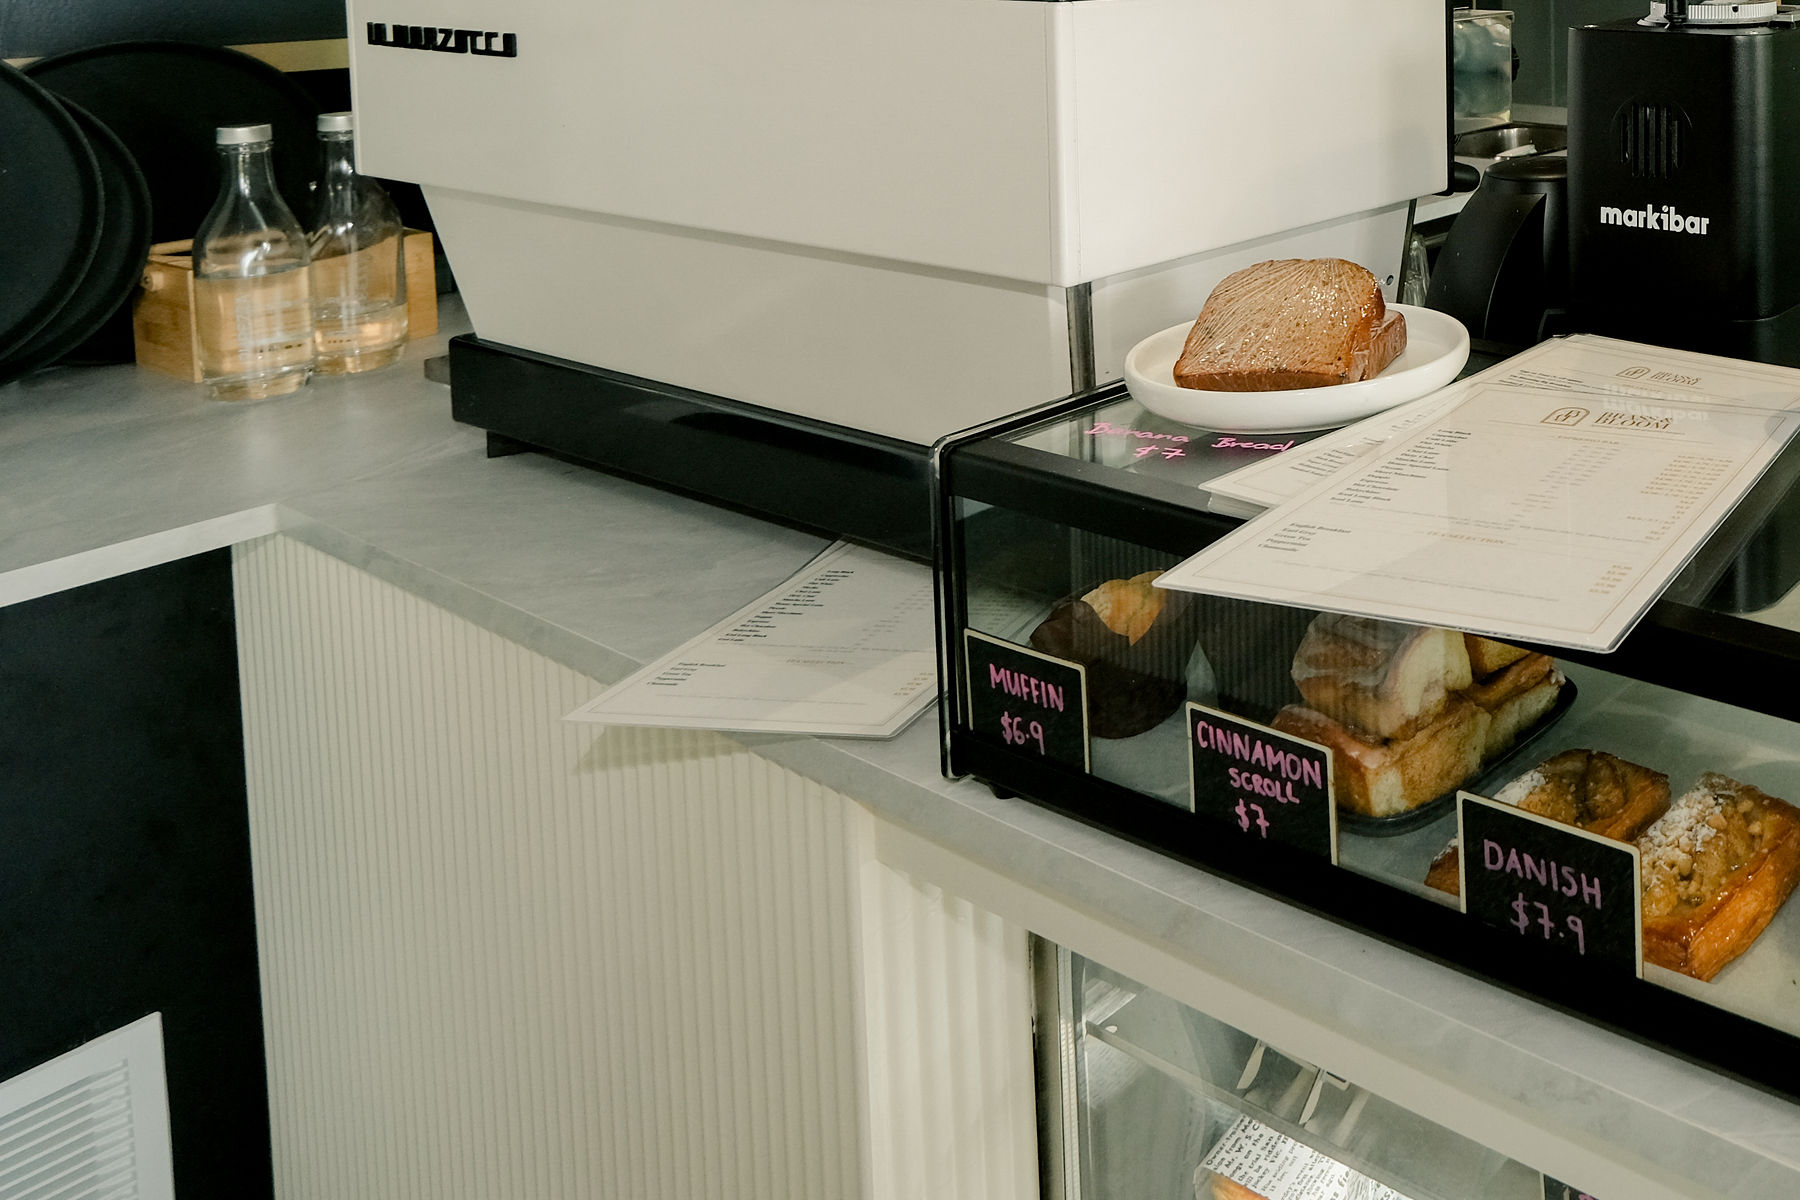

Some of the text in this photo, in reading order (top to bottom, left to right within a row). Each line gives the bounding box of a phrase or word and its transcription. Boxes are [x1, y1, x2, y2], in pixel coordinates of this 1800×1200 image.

[1600, 203, 1710, 235] markibar
[1084, 421, 1295, 452] Banana Bread
[1592, 417, 1670, 429] BLOOM
[1133, 444, 1186, 460] $7
[988, 663, 1065, 713] MUFFIN
[999, 709, 1045, 756] $6.9
[1196, 718, 1323, 789] CINNAMON
[1228, 767, 1301, 805] SCROLL
[1233, 802, 1270, 838] $7
[1482, 837, 1602, 910] DANISH
[1509, 892, 1585, 956] $7.9
[1223, 1133, 1242, 1155] from
[1233, 1139, 1248, 1156] W.
[1250, 1131, 1264, 1147] the
